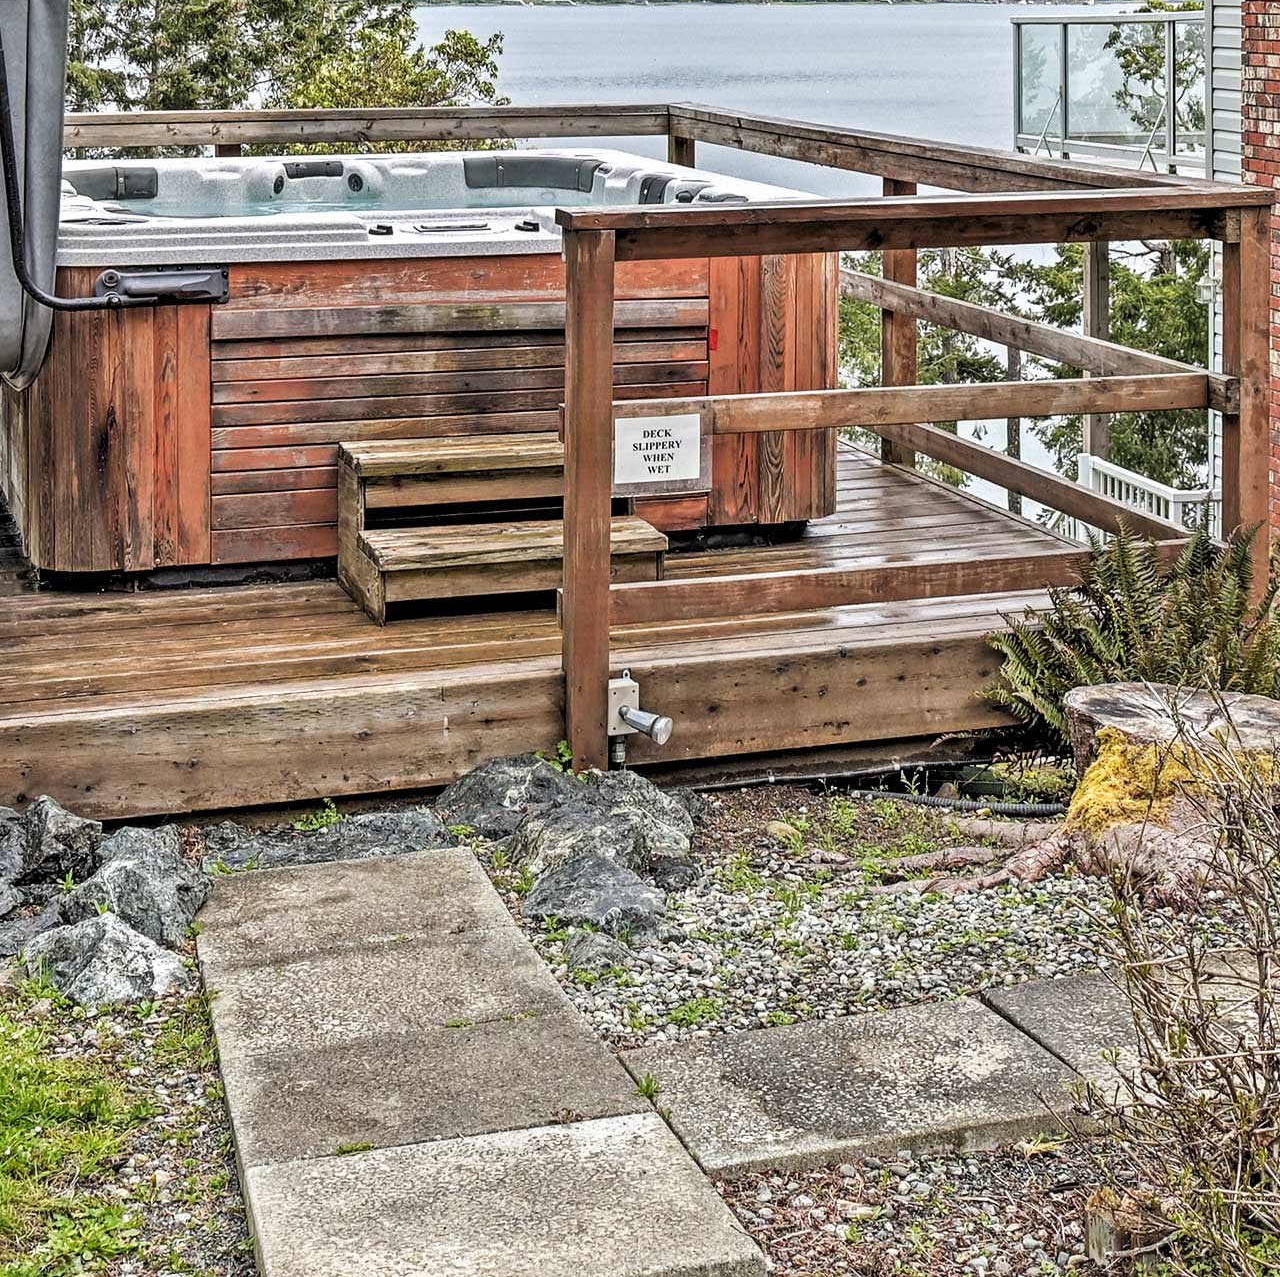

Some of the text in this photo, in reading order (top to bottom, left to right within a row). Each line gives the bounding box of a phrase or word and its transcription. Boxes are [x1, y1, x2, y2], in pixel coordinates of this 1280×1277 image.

[643, 428, 672, 439] DECK
[632, 440, 682, 452] SLIPPERY
[643, 452, 674, 463] WHEN
[647, 464, 671, 474] WET
